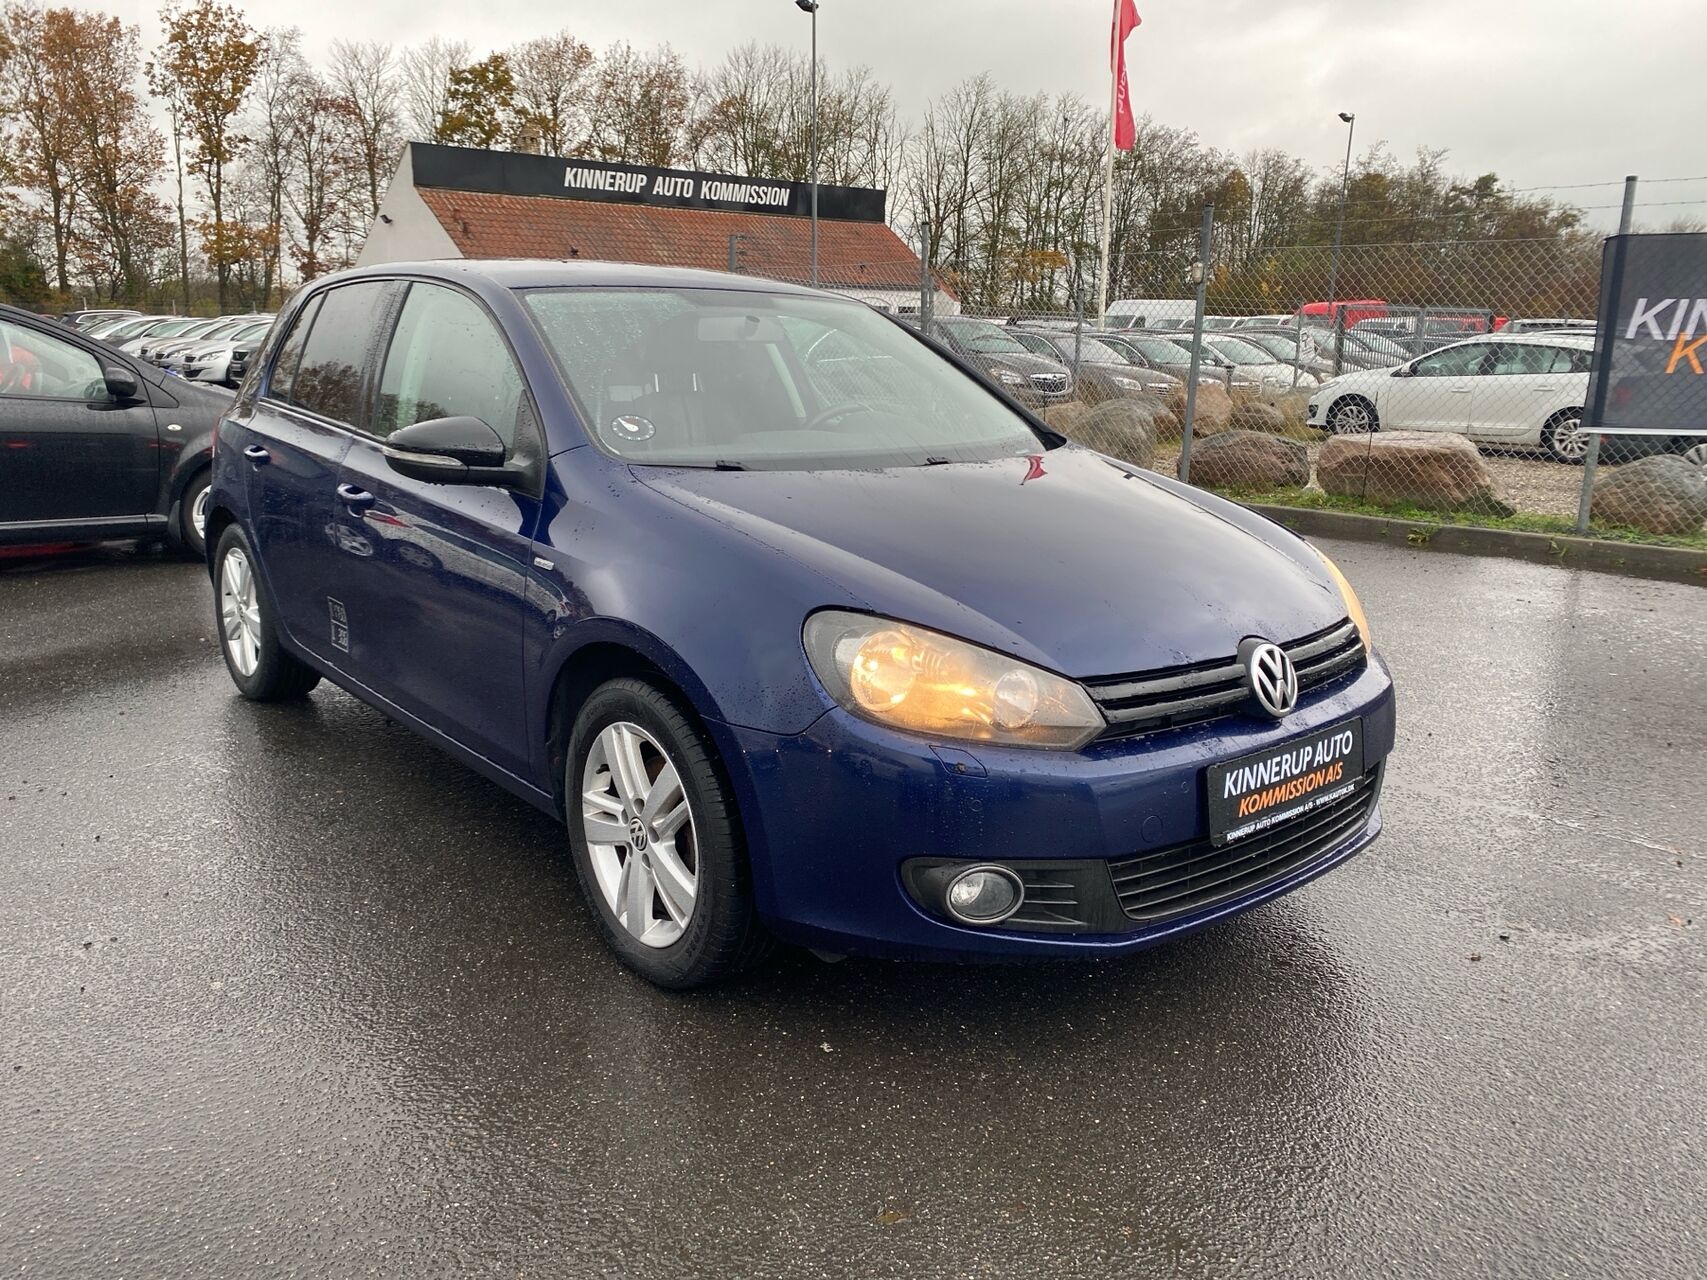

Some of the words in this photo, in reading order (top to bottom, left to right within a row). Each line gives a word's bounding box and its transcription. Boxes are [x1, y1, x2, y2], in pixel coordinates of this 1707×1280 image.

[564, 167, 648, 194] KINNERUP
[652, 176, 694, 198] AUTO
[700, 180, 790, 207] KOMMISSION
[1223, 746, 1312, 799] KINNERUP
[1313, 730, 1354, 767] AUTO
[1238, 771, 1326, 818] KOMMISSION
[1226, 824, 1256, 841] KINNERUP
[1255, 818, 1271, 831] AUTO
